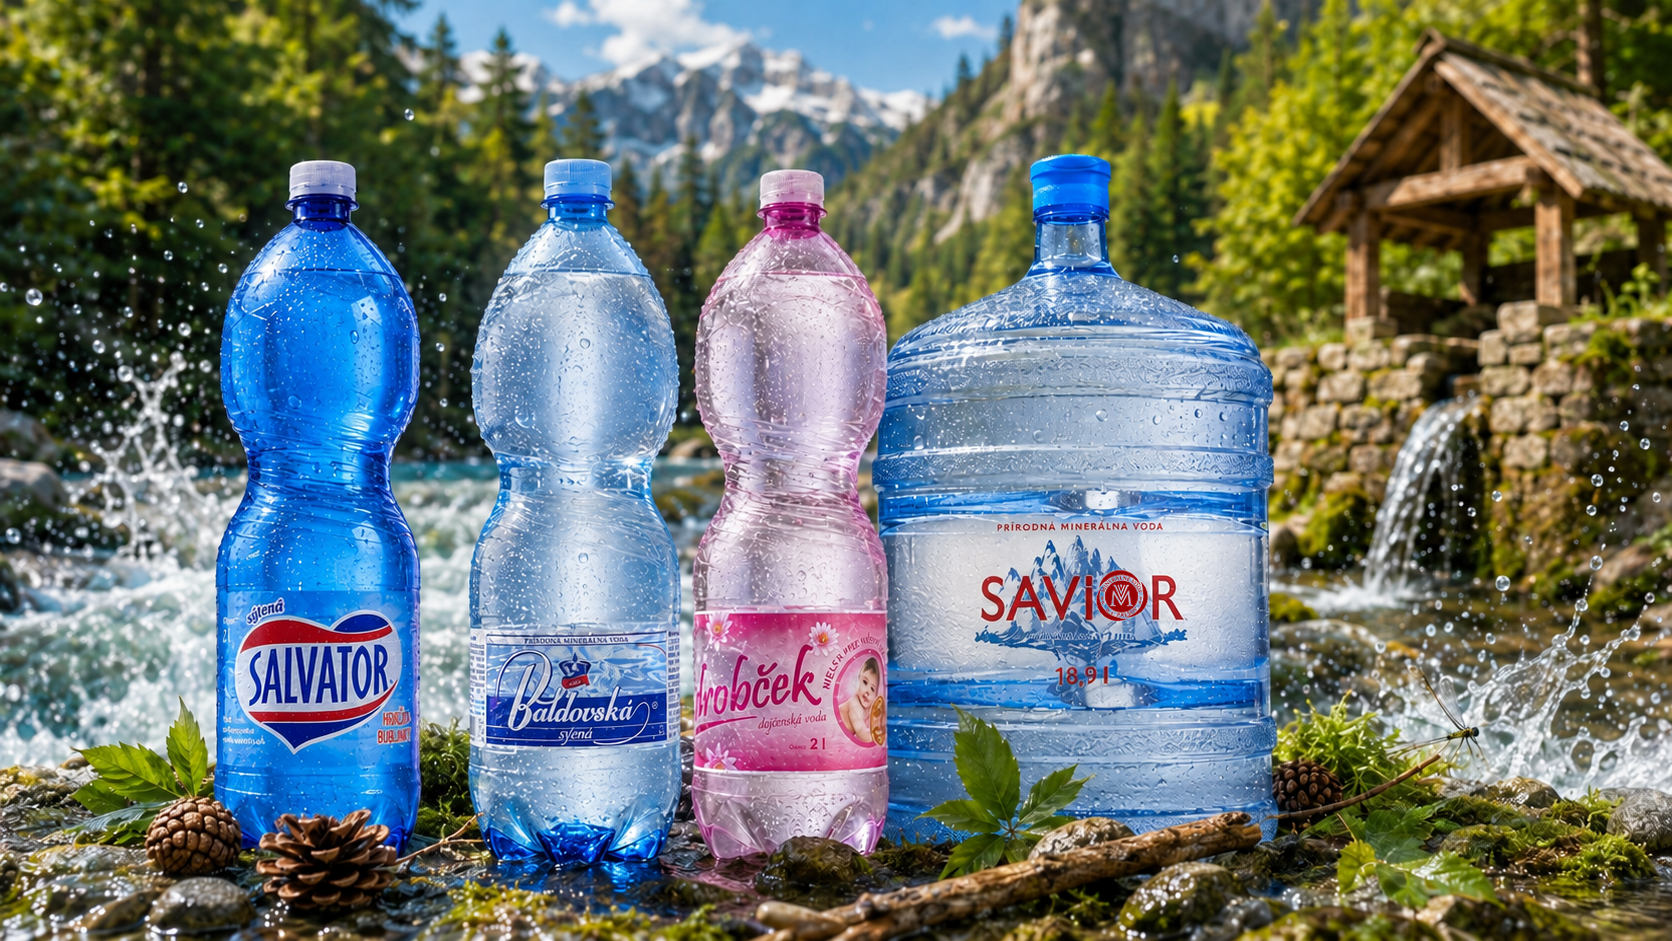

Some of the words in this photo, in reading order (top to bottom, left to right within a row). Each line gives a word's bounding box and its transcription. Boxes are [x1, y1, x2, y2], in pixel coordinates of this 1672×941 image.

[997, 521, 1056, 532] PRÍRODNÁ
[1060, 521, 1128, 532] MINERÁLNA
[1133, 522, 1164, 532] VODA
[248, 644, 389, 707] SALVATOR
[1055, 666, 1098, 688] 18,9
[494, 650, 650, 734] Baldovská
[805, 709, 827, 723] voda
[810, 737, 818, 750] 2
